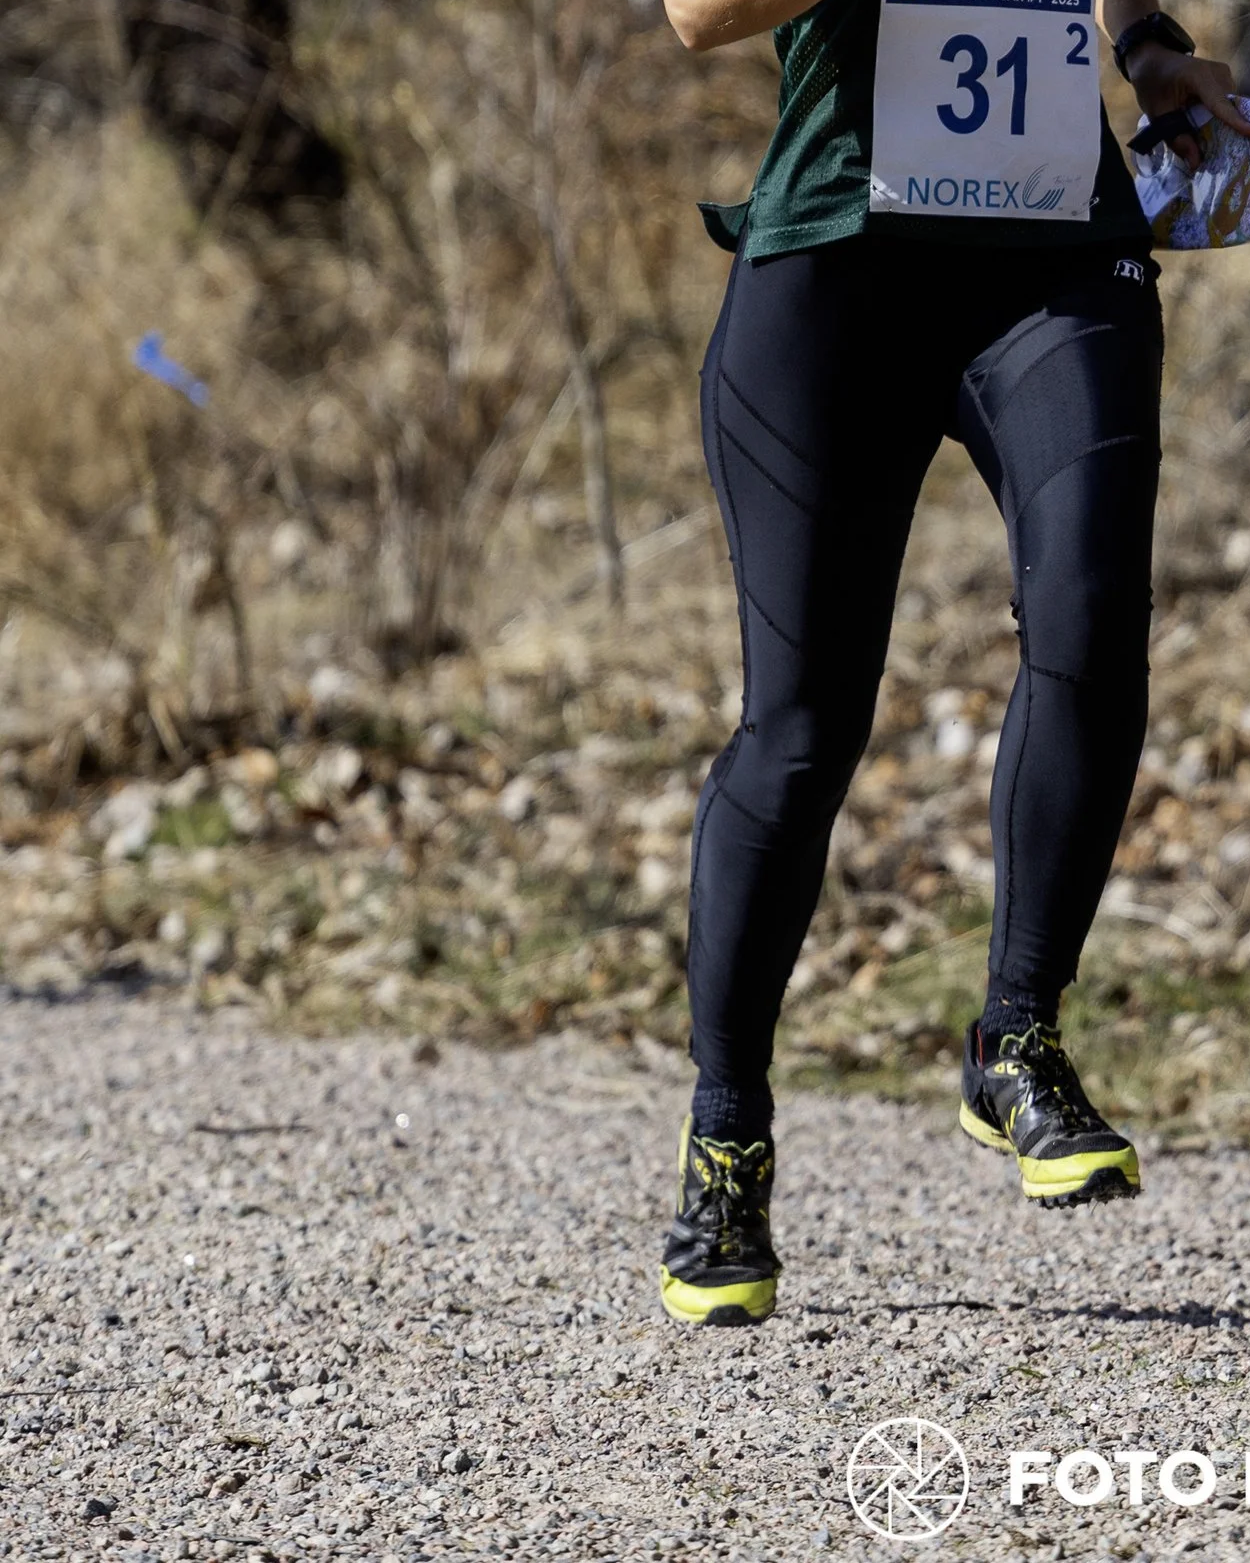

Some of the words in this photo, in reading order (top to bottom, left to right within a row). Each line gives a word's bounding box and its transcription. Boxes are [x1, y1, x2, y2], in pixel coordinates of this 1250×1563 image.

[1065, 22, 1090, 66] 2
[936, 34, 1028, 136] 31
[907, 176, 1020, 211] NOREX
